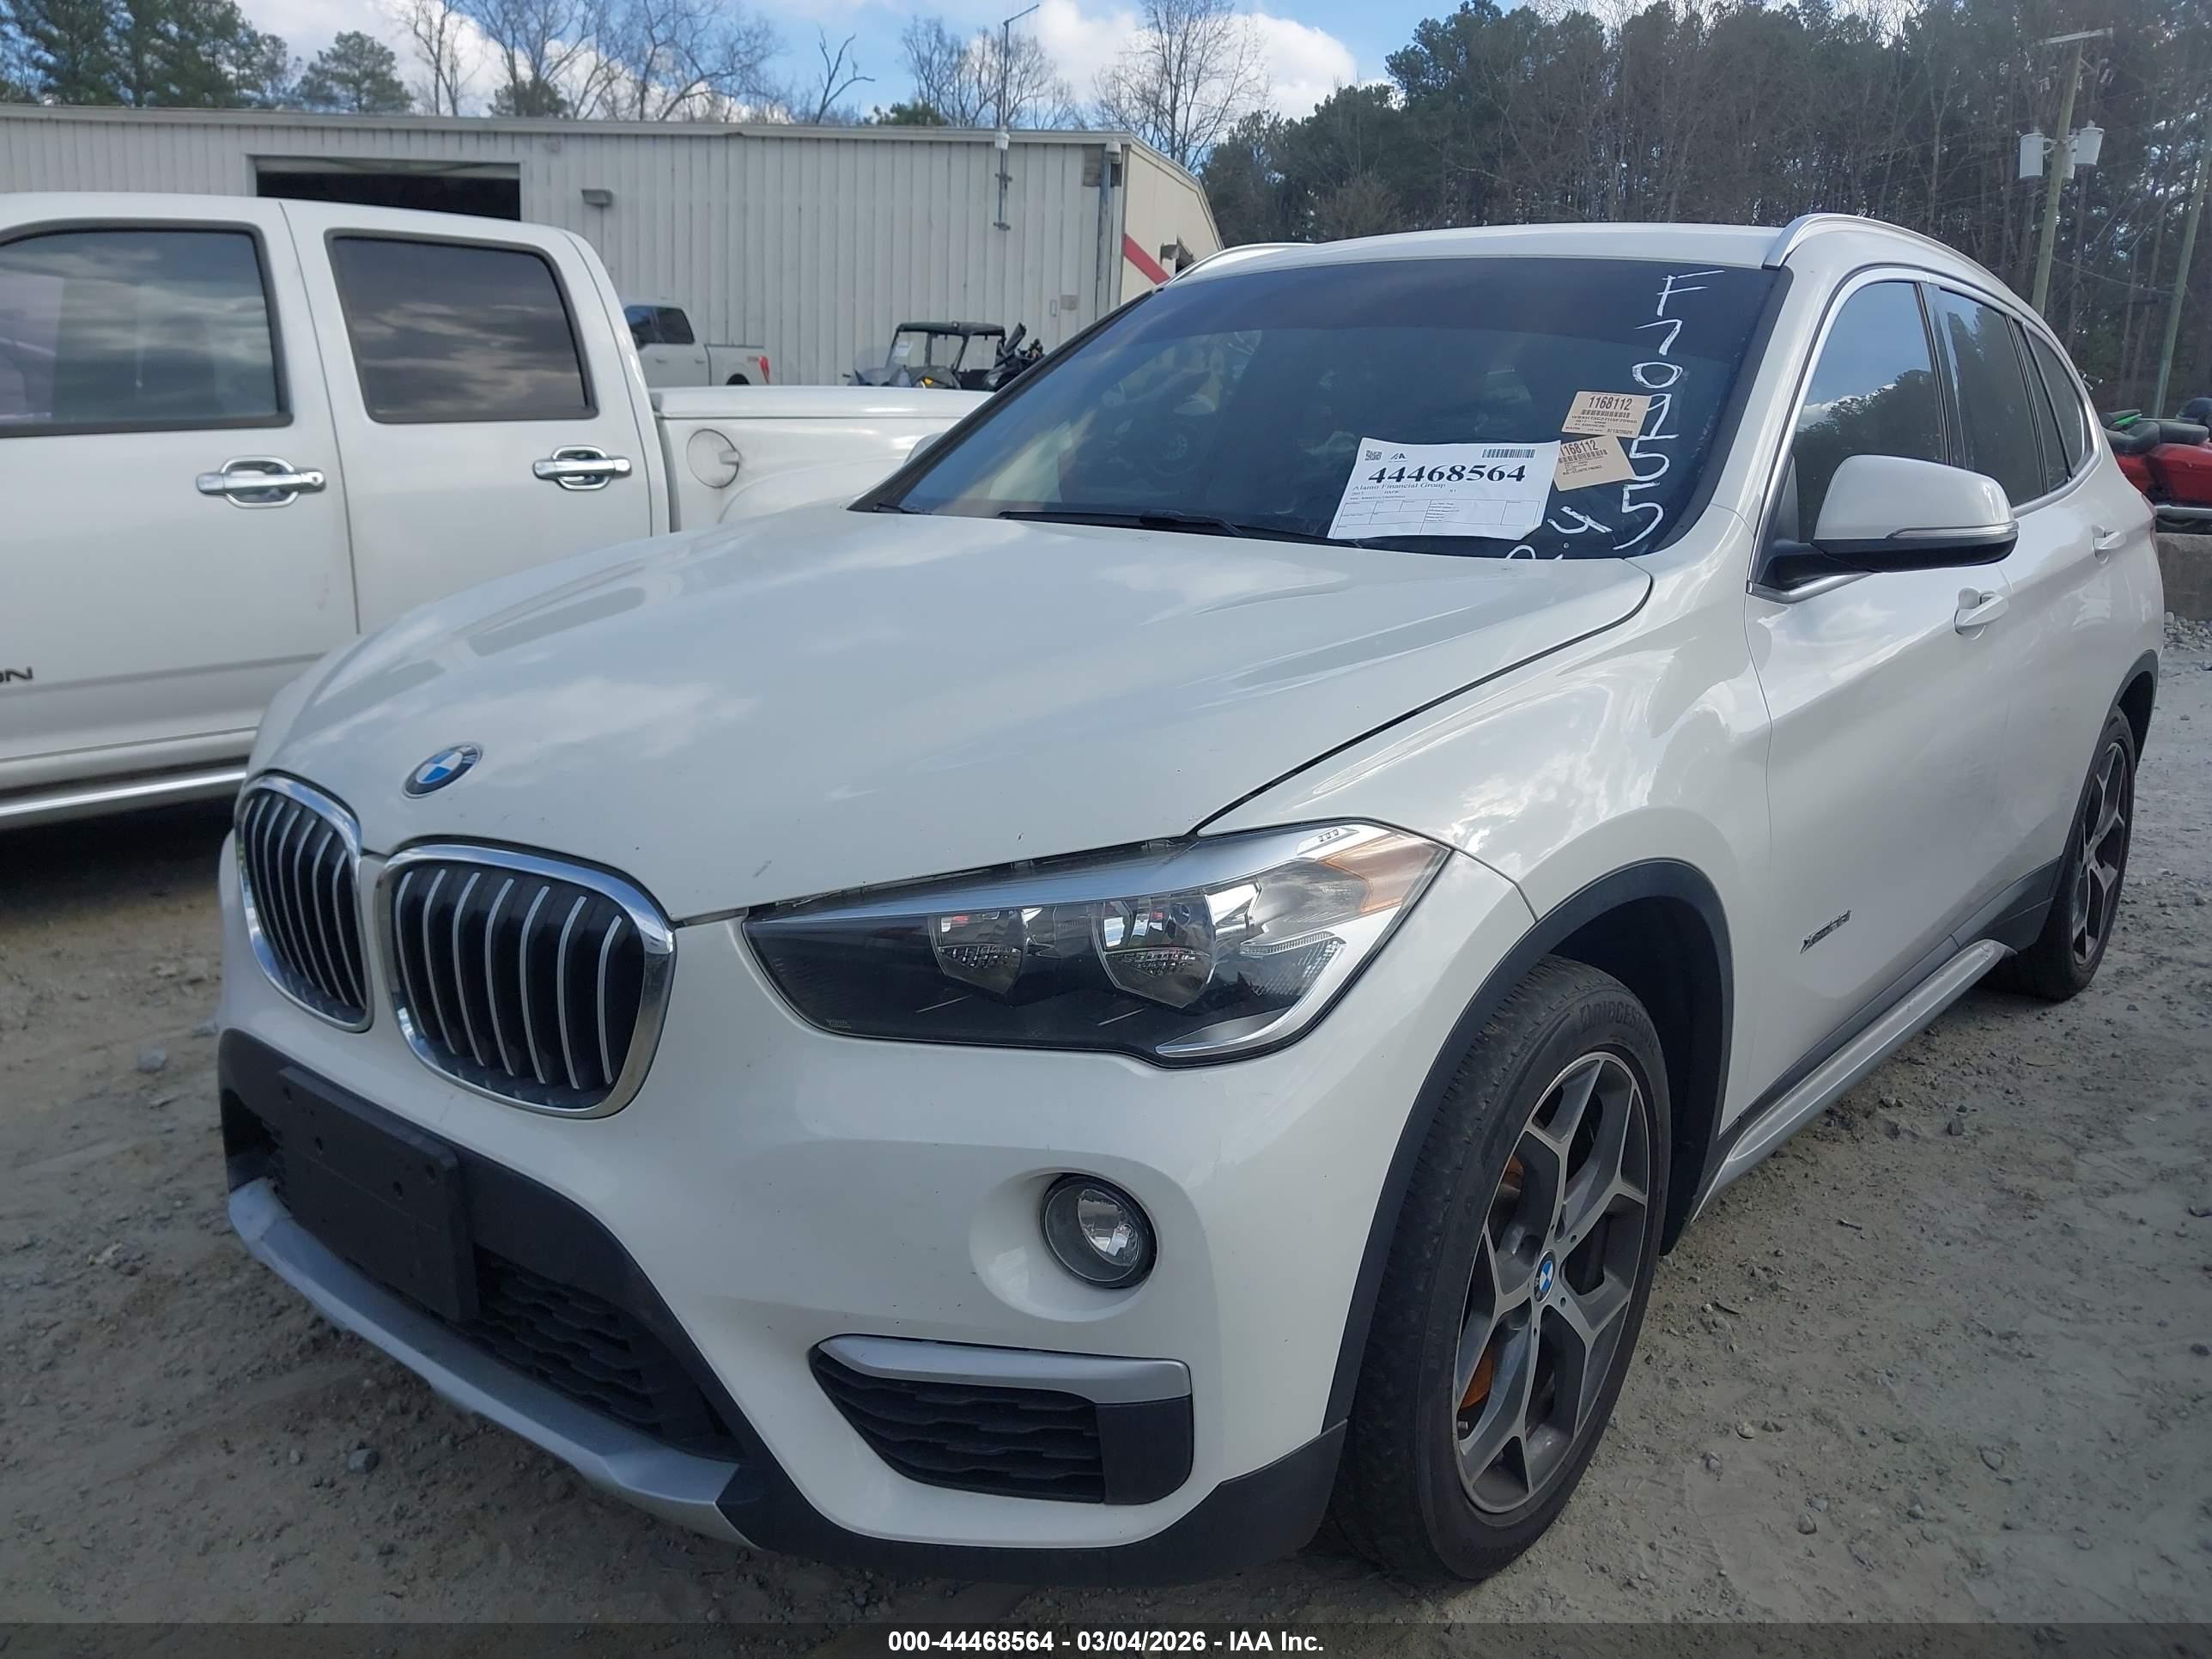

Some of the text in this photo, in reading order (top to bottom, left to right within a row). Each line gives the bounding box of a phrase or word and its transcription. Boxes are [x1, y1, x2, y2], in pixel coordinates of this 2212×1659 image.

[1589, 396, 1632, 410] 1168112
[1611, 270, 1725, 551] F70955
[1560, 440, 1599, 456] 1168112
[1368, 465, 1526, 483] 44468564
[0, 665, 33, 684] N
